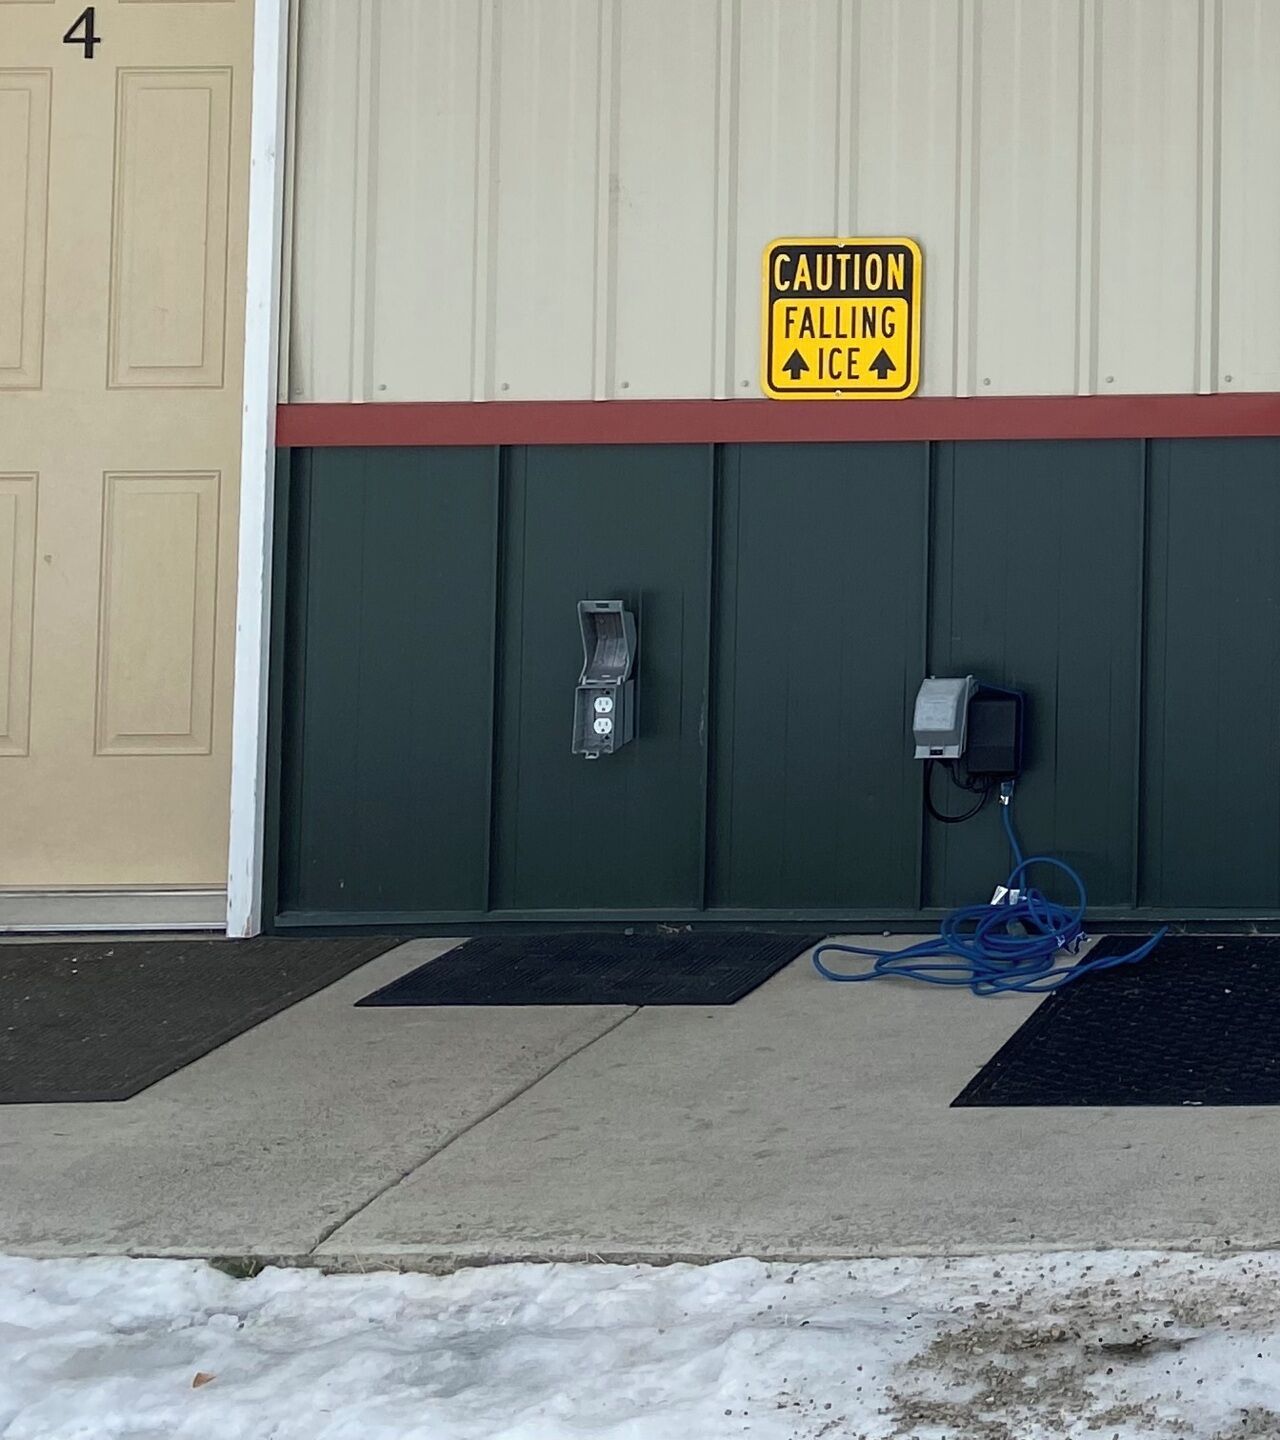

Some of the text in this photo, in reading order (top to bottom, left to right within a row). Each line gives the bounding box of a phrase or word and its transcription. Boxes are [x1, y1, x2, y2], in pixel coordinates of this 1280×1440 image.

[63, 7, 101, 59] 4
[774, 253, 905, 291] CAUTION
[784, 306, 896, 339] FALLING
[818, 347, 861, 380] ICE
